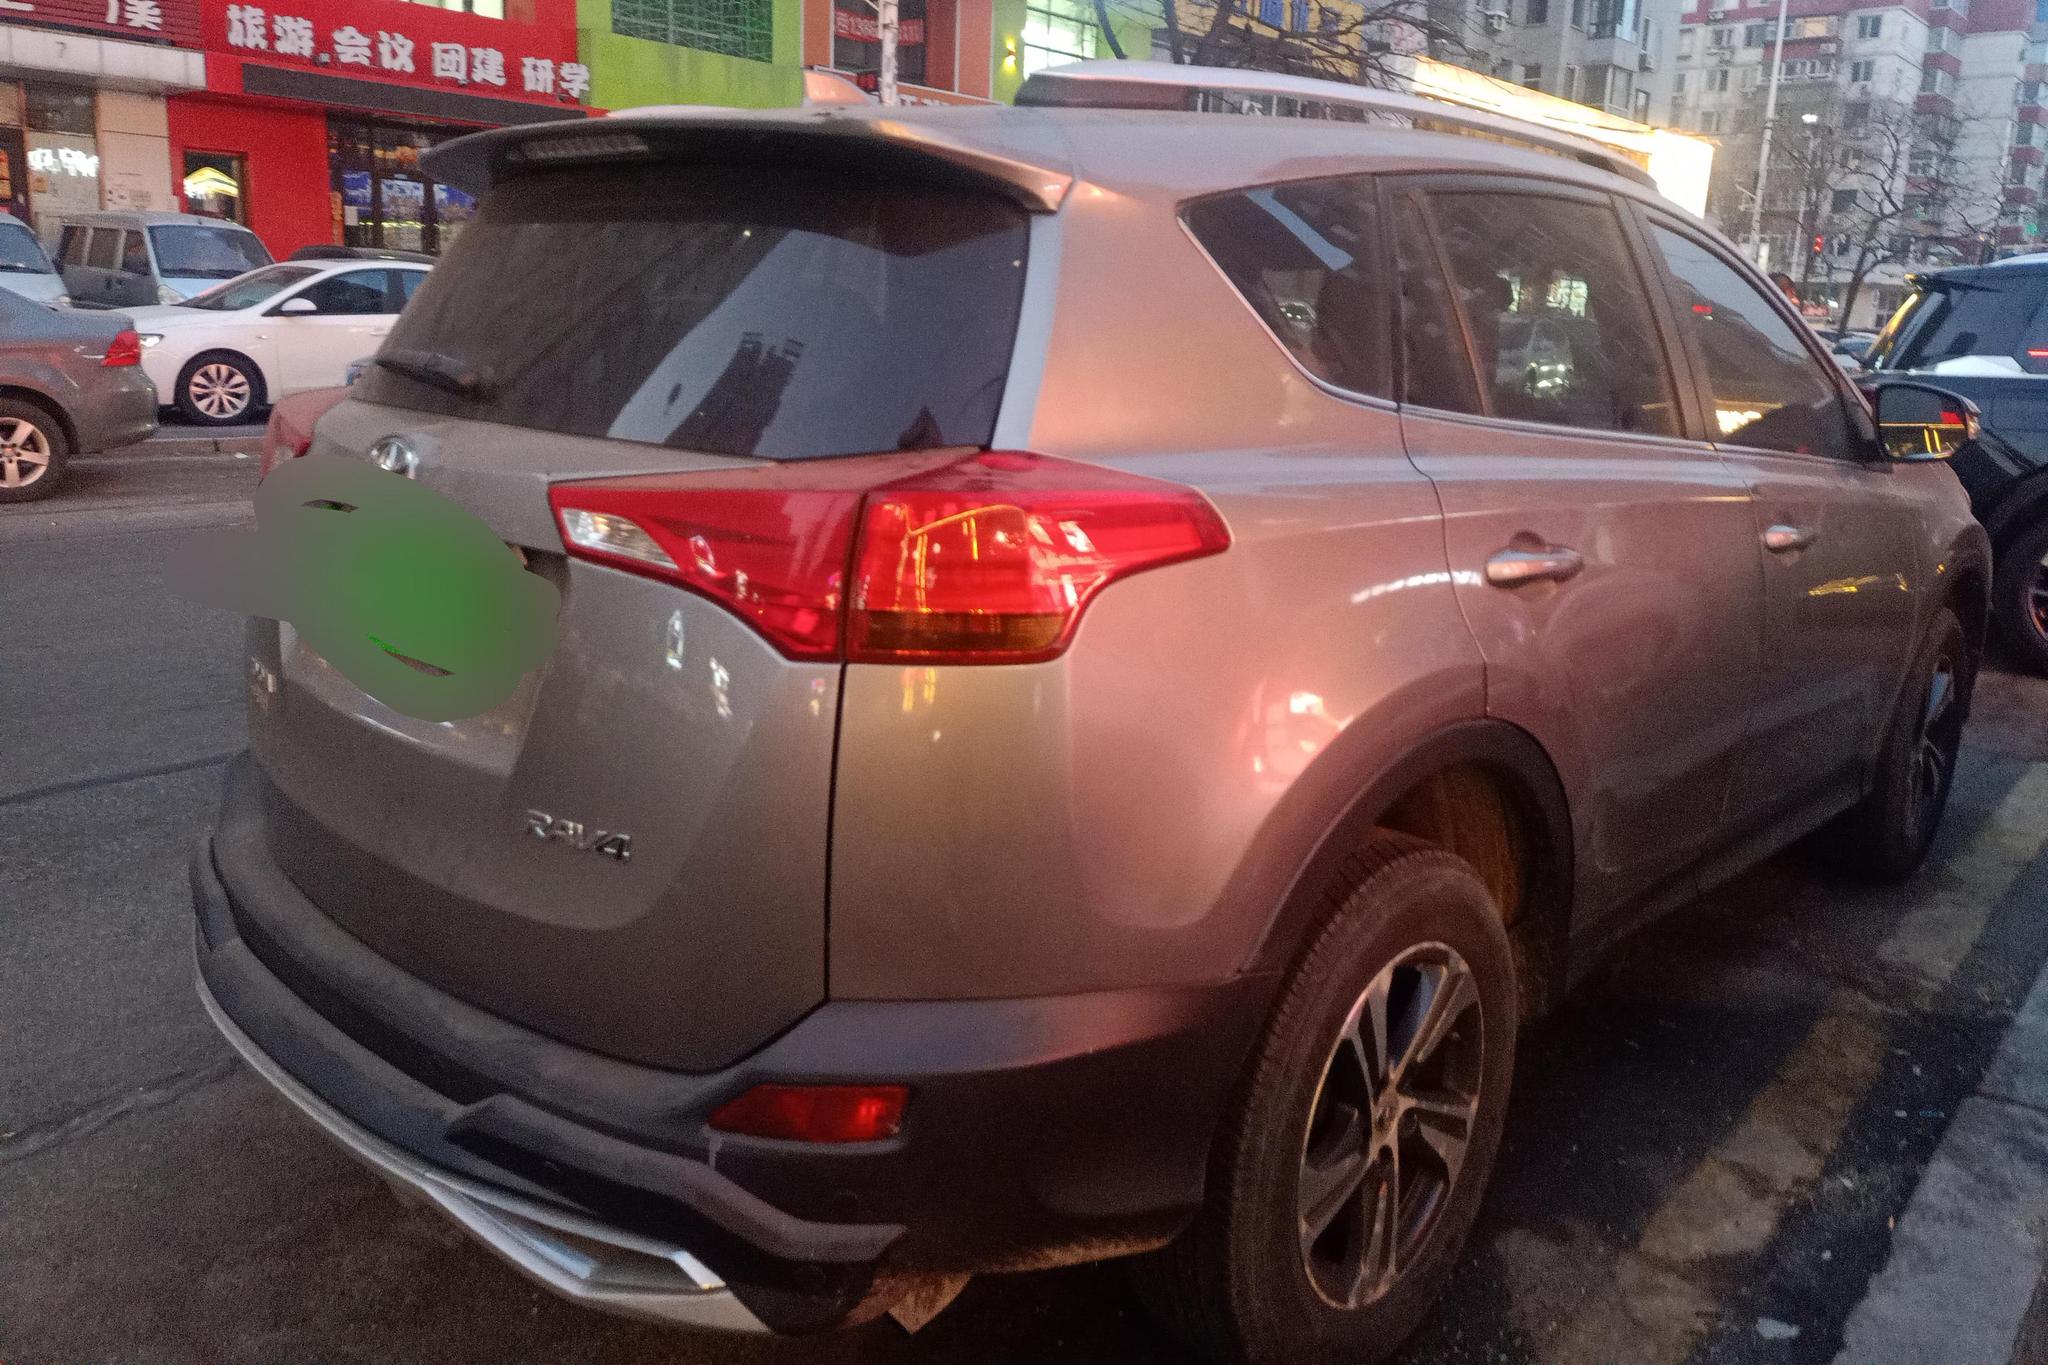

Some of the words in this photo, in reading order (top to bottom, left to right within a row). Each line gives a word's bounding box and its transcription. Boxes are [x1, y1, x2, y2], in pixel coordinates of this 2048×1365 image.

[226, 4, 315, 58] 旅游
[332, 25, 416, 73] 会议
[521, 57, 591, 98] 研学
[527, 808, 633, 862] RAV4
